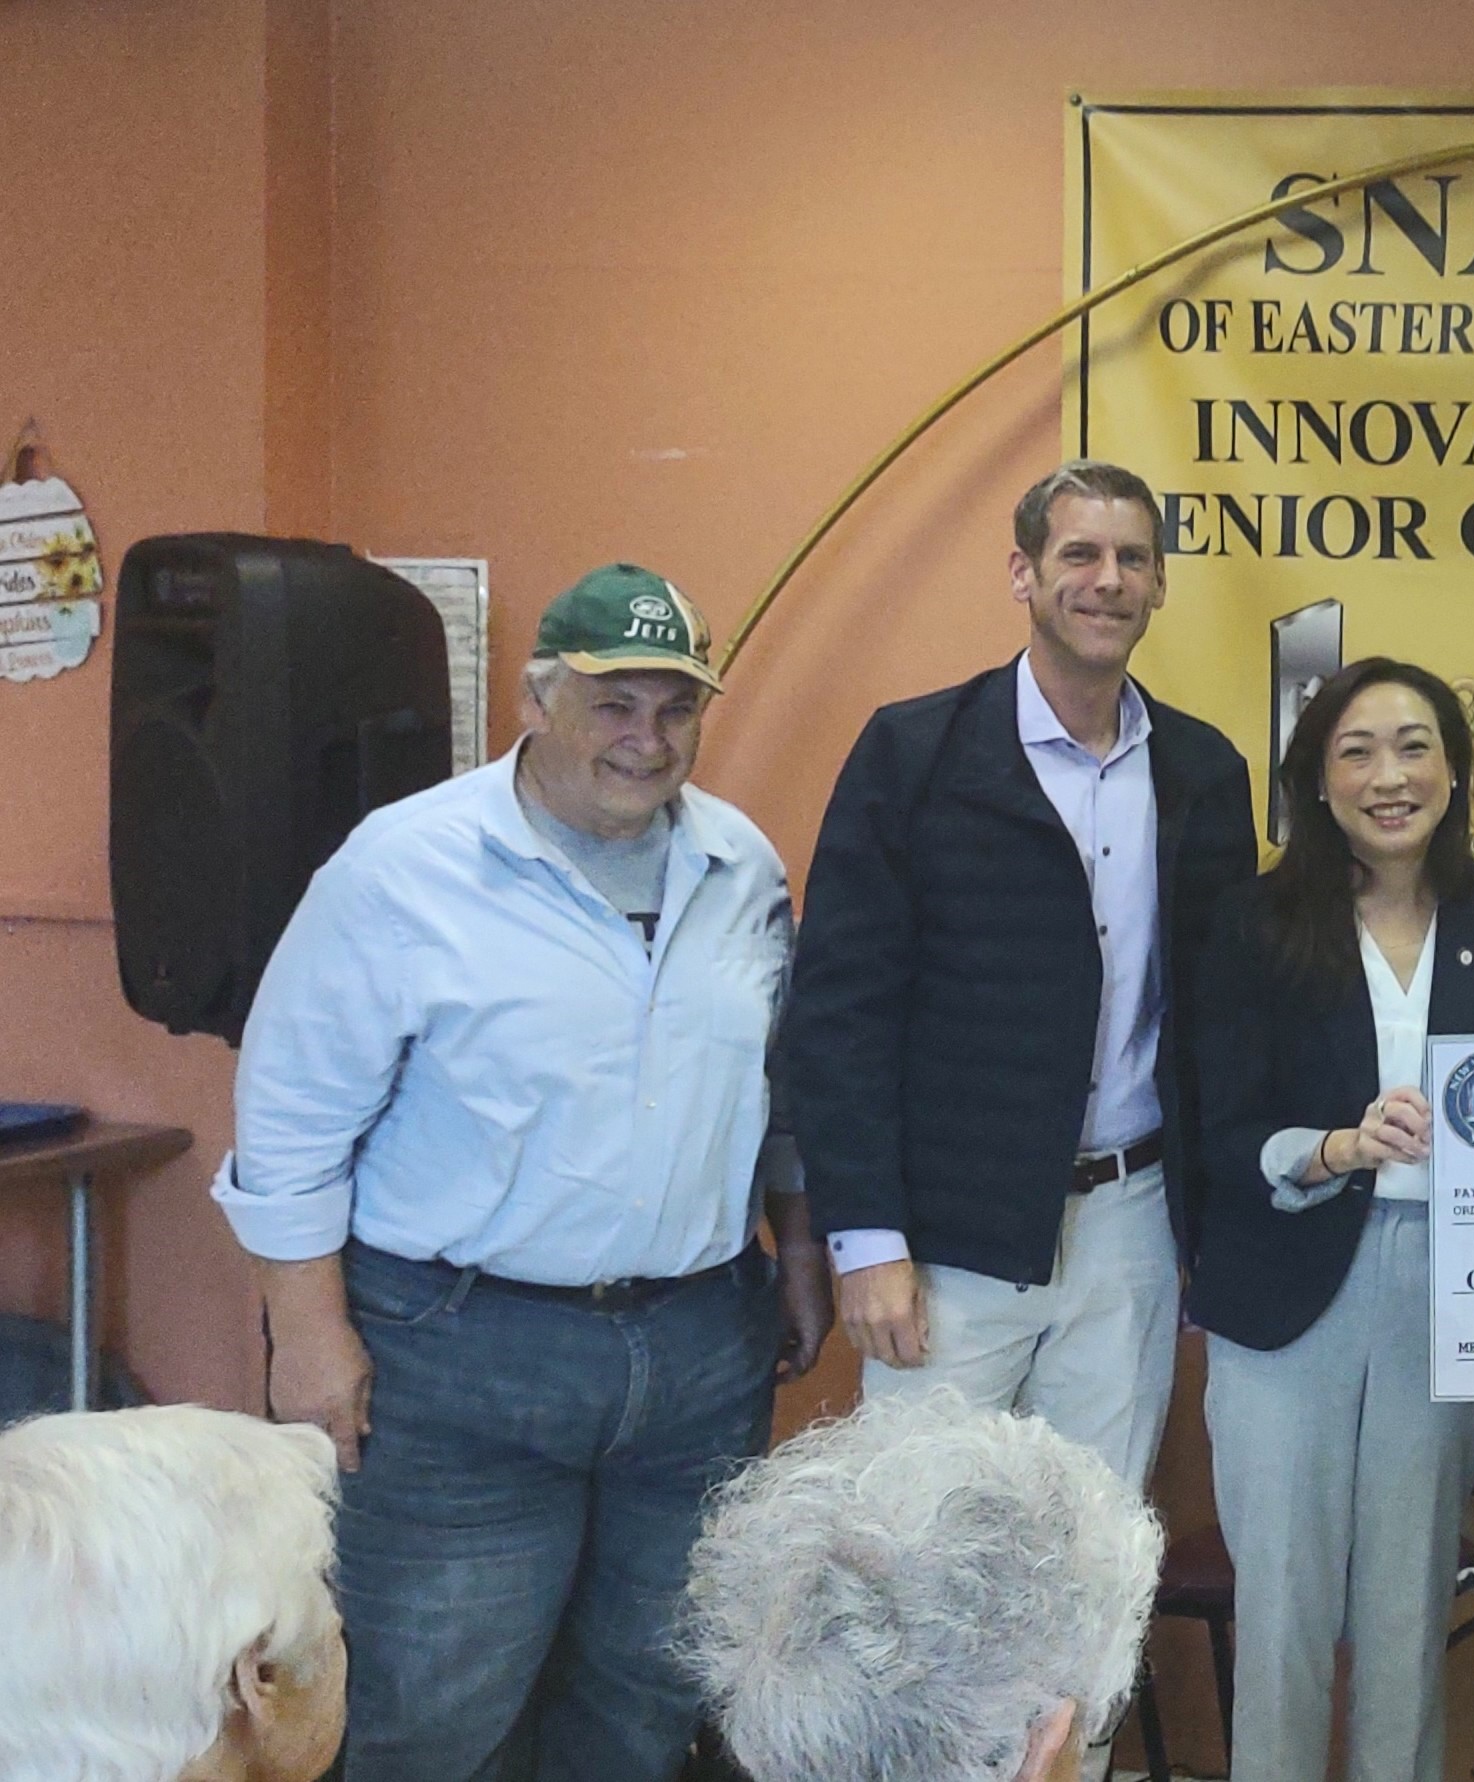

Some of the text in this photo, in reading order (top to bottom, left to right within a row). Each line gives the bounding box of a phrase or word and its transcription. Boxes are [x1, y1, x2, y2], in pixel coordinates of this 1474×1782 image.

[1158, 301, 1234, 354] OF
[1158, 492, 1435, 560] ENIOR
[623, 618, 677, 641] JETS
